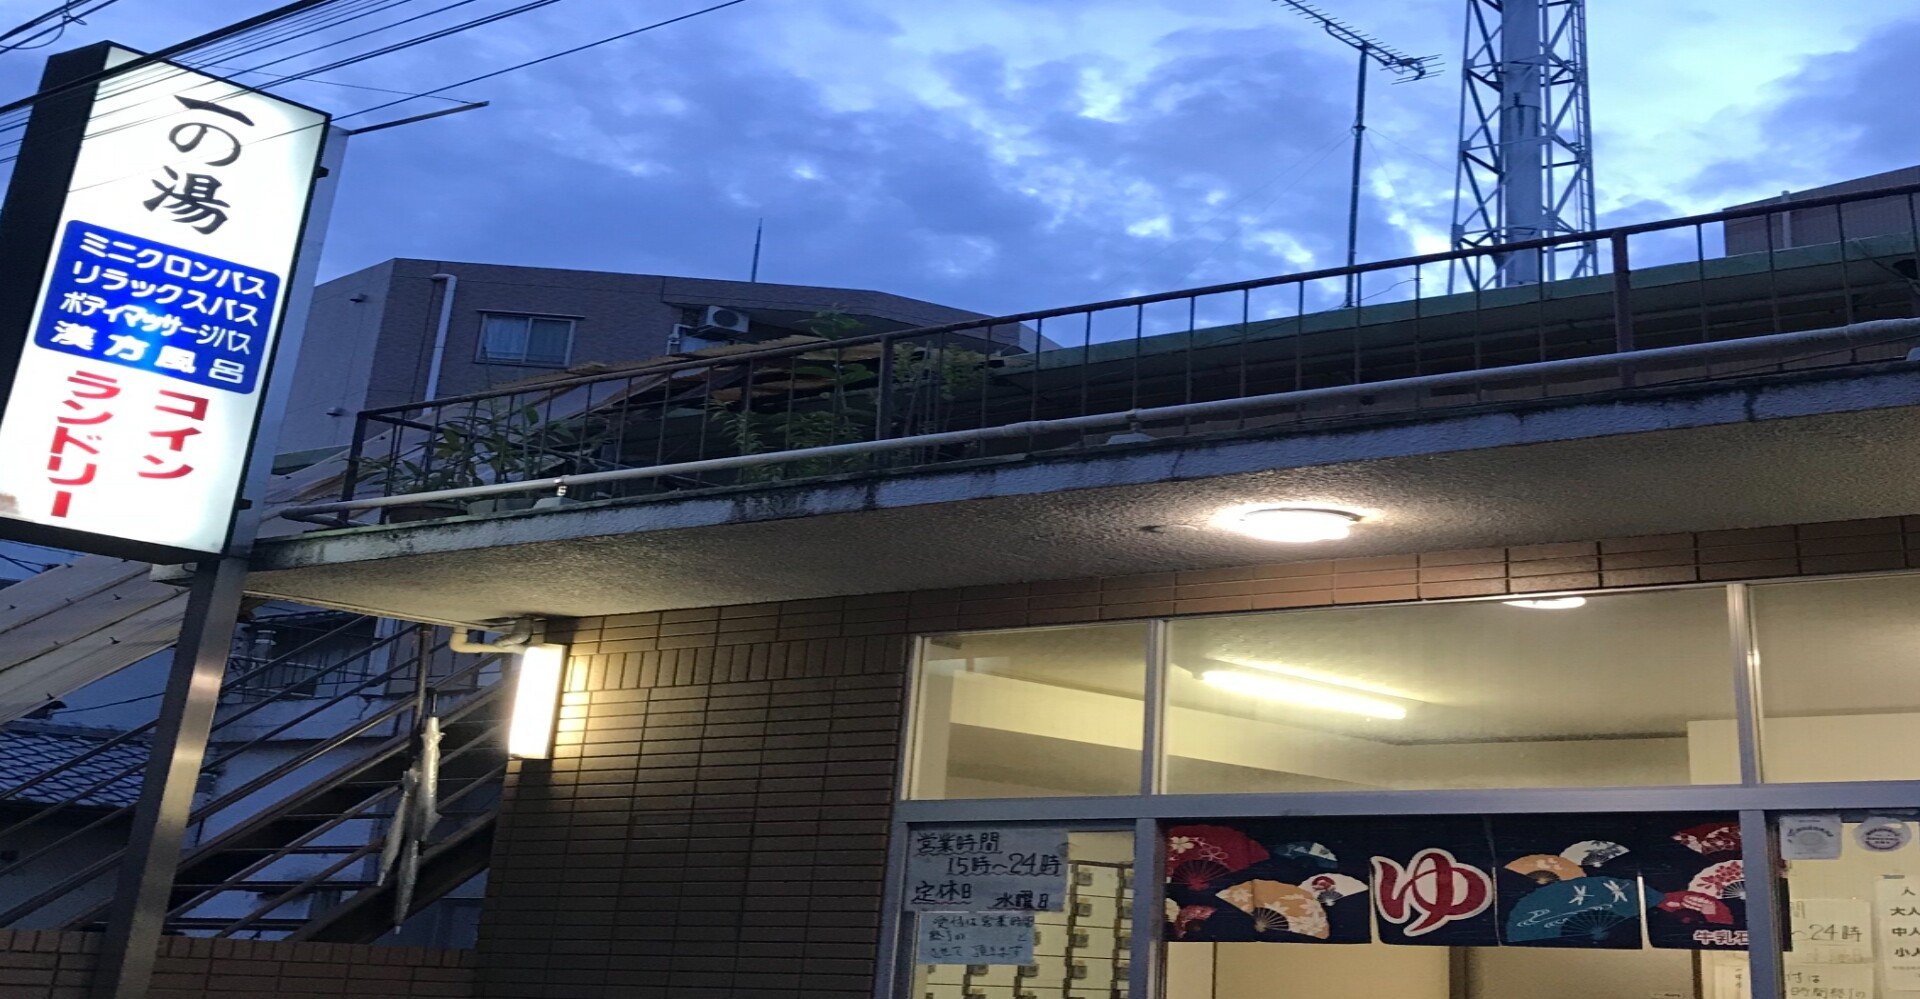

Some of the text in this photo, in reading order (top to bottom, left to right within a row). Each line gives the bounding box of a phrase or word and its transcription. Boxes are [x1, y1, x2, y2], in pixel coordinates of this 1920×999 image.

[143, 94, 256, 235] 一の湯
[73, 261, 259, 327] リラックスバス
[80, 231, 267, 299] ミニクロンバス
[50, 320, 245, 384] 漢方風呂
[47, 370, 121, 518] ランドリー
[137, 389, 210, 479] コイン
[917, 831, 1001, 852] 営業時間
[911, 880, 973, 903] 定休日
[994, 890, 1050, 910] 水曜日
[1371, 848, 1494, 937] ゆ
[1889, 906, 1920, 917] 大人
